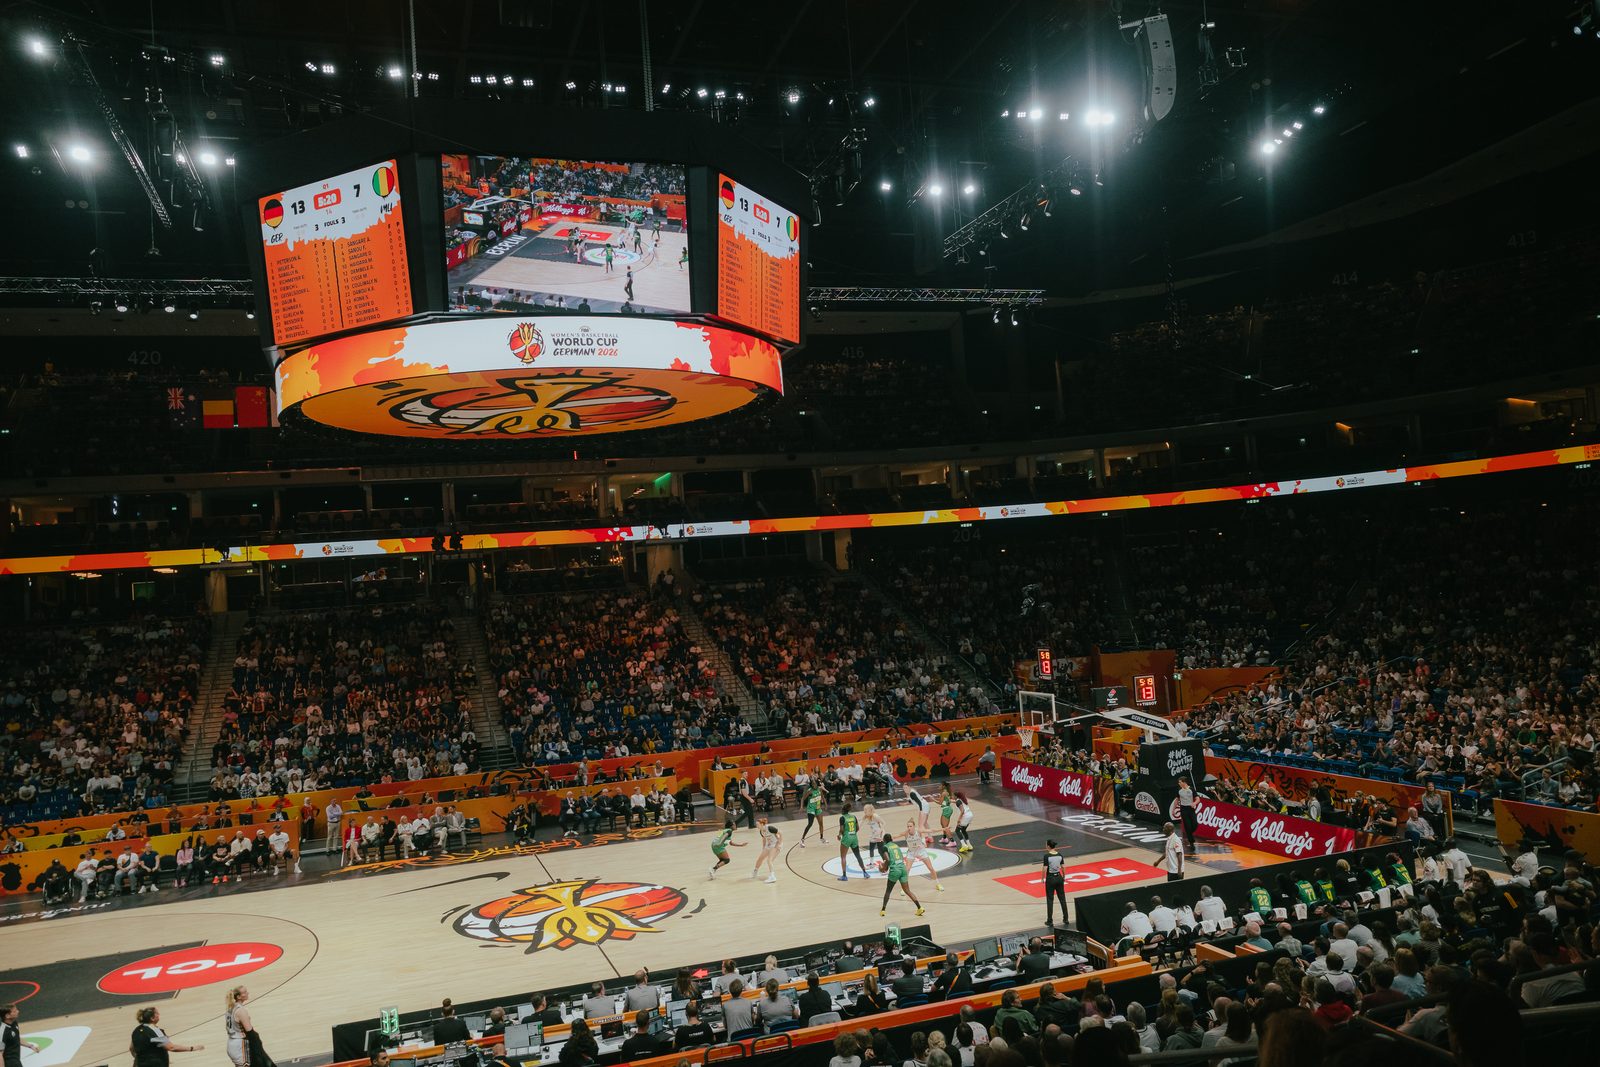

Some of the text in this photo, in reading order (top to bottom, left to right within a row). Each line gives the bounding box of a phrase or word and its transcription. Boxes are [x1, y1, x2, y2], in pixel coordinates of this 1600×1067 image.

[354, 184, 360, 198] 7
[291, 200, 306, 215] 13
[740, 198, 748, 212] 13
[324, 219, 339, 228] FOULS
[776, 216, 781, 228] 7
[270, 232, 284, 244] GER
[486, 235, 527, 255] BERLIN
[553, 338, 618, 346] WORLD CUP
[128, 350, 161, 366] 420
[554, 348, 618, 356] GERMANY 2026
[1142, 686, 1154, 700] 13
[1168, 748, 1187, 760] #We
[1011, 764, 1044, 792] Kellogg's
[1061, 814, 1182, 843] BERLIN
[1250, 806, 1316, 856] Kellogg's
[1257, 894, 1271, 906] 22
[122, 952, 265, 980] TCL
